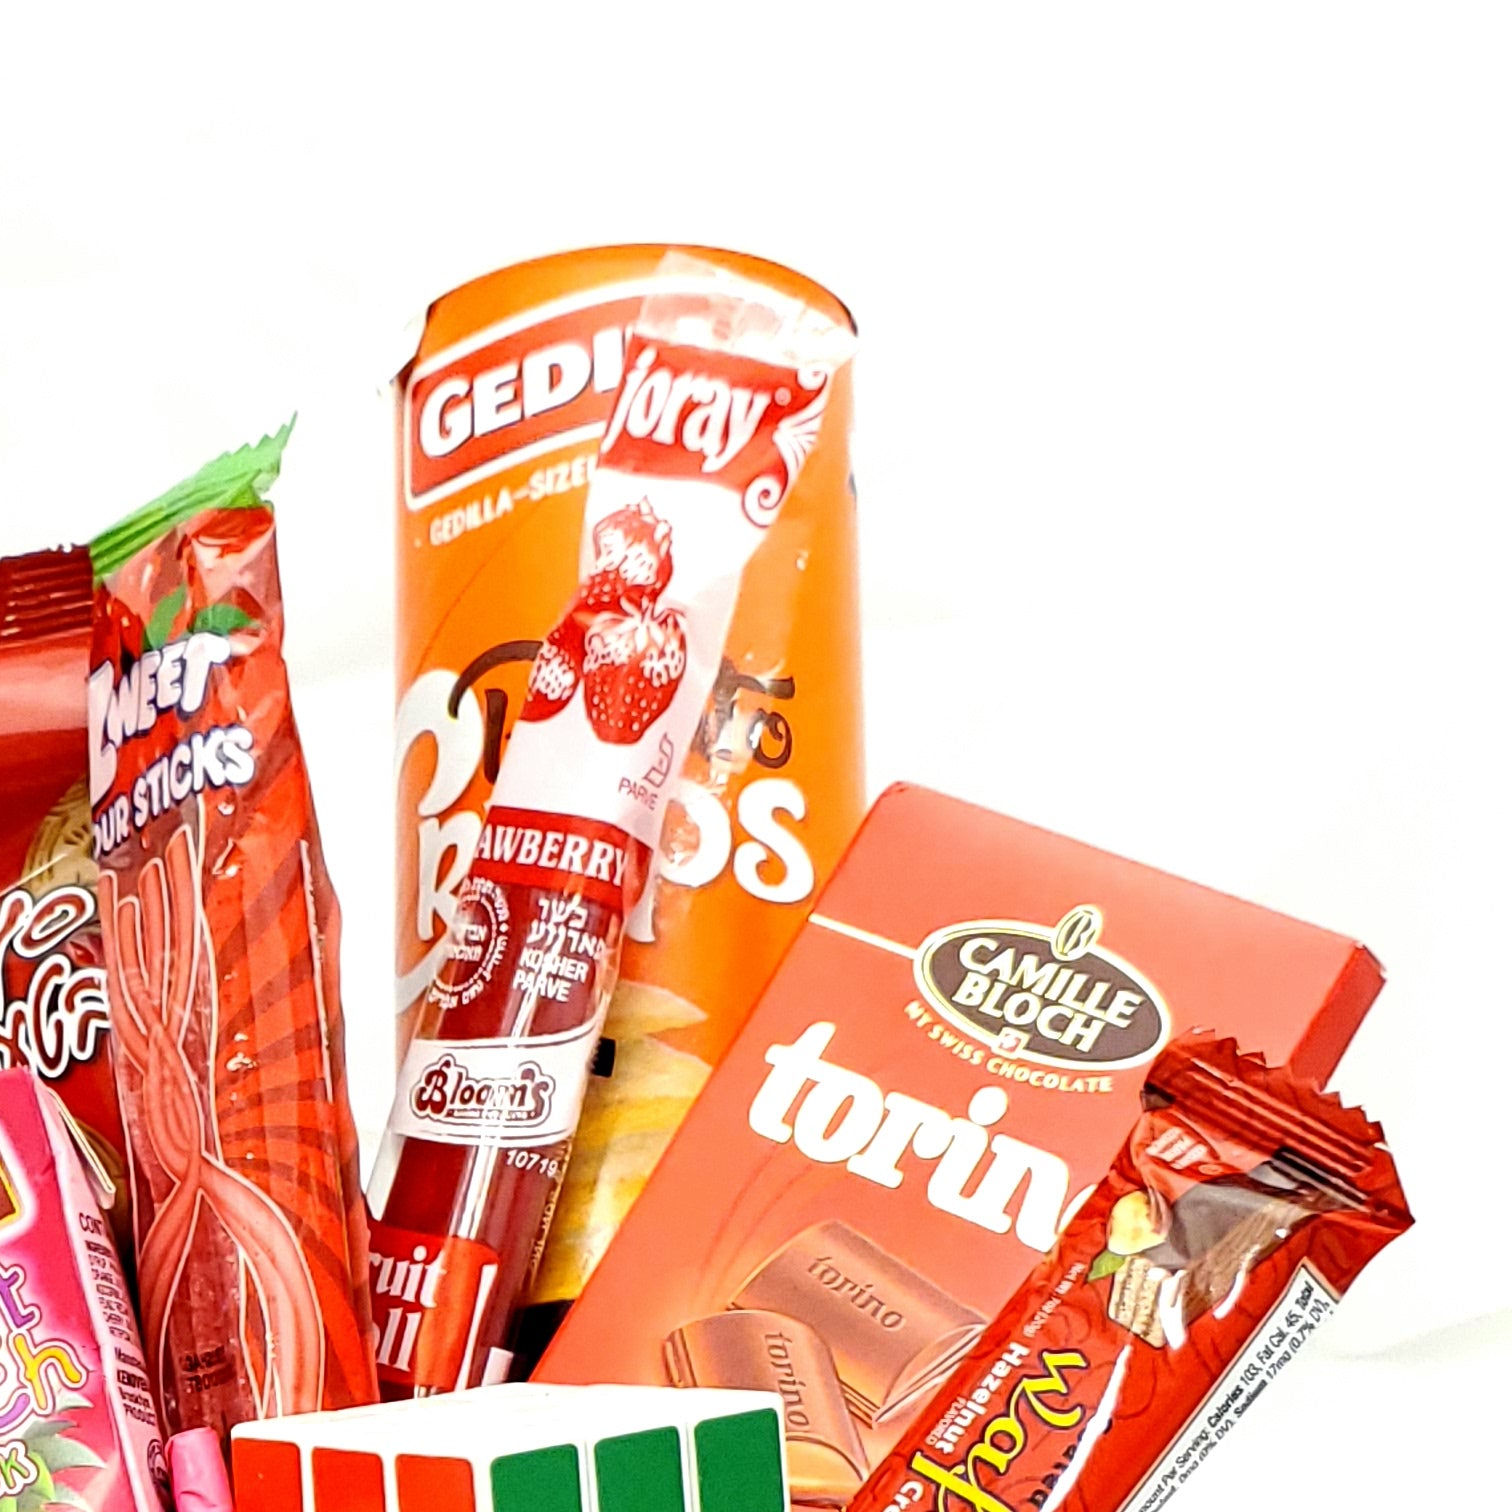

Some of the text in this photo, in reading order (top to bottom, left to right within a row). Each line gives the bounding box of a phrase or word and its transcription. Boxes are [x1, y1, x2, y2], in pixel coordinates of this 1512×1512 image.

[419, 327, 622, 458] GEDI
[92, 724, 256, 860] OUR STICKS
[618, 777, 658, 811] PARE
[476, 824, 627, 887] AWBERRY
[512, 969, 572, 1003] PARVE
[519, 947, 589, 983] KOSHER
[958, 937, 1143, 1029] CAMILLE
[952, 971, 1106, 1052] BLOCH
[927, 1024, 985, 1066] SWISS
[986, 1057, 1114, 1093] CHOCOLATE
[748, 1021, 1095, 1253] torin
[368, 1245, 447, 1309] uit
[807, 1256, 904, 1330] torino
[764, 1331, 811, 1427] torino
[935, 1341, 1030, 1455] Hazelnut
[1204, 1382, 1246, 1429] Calories
